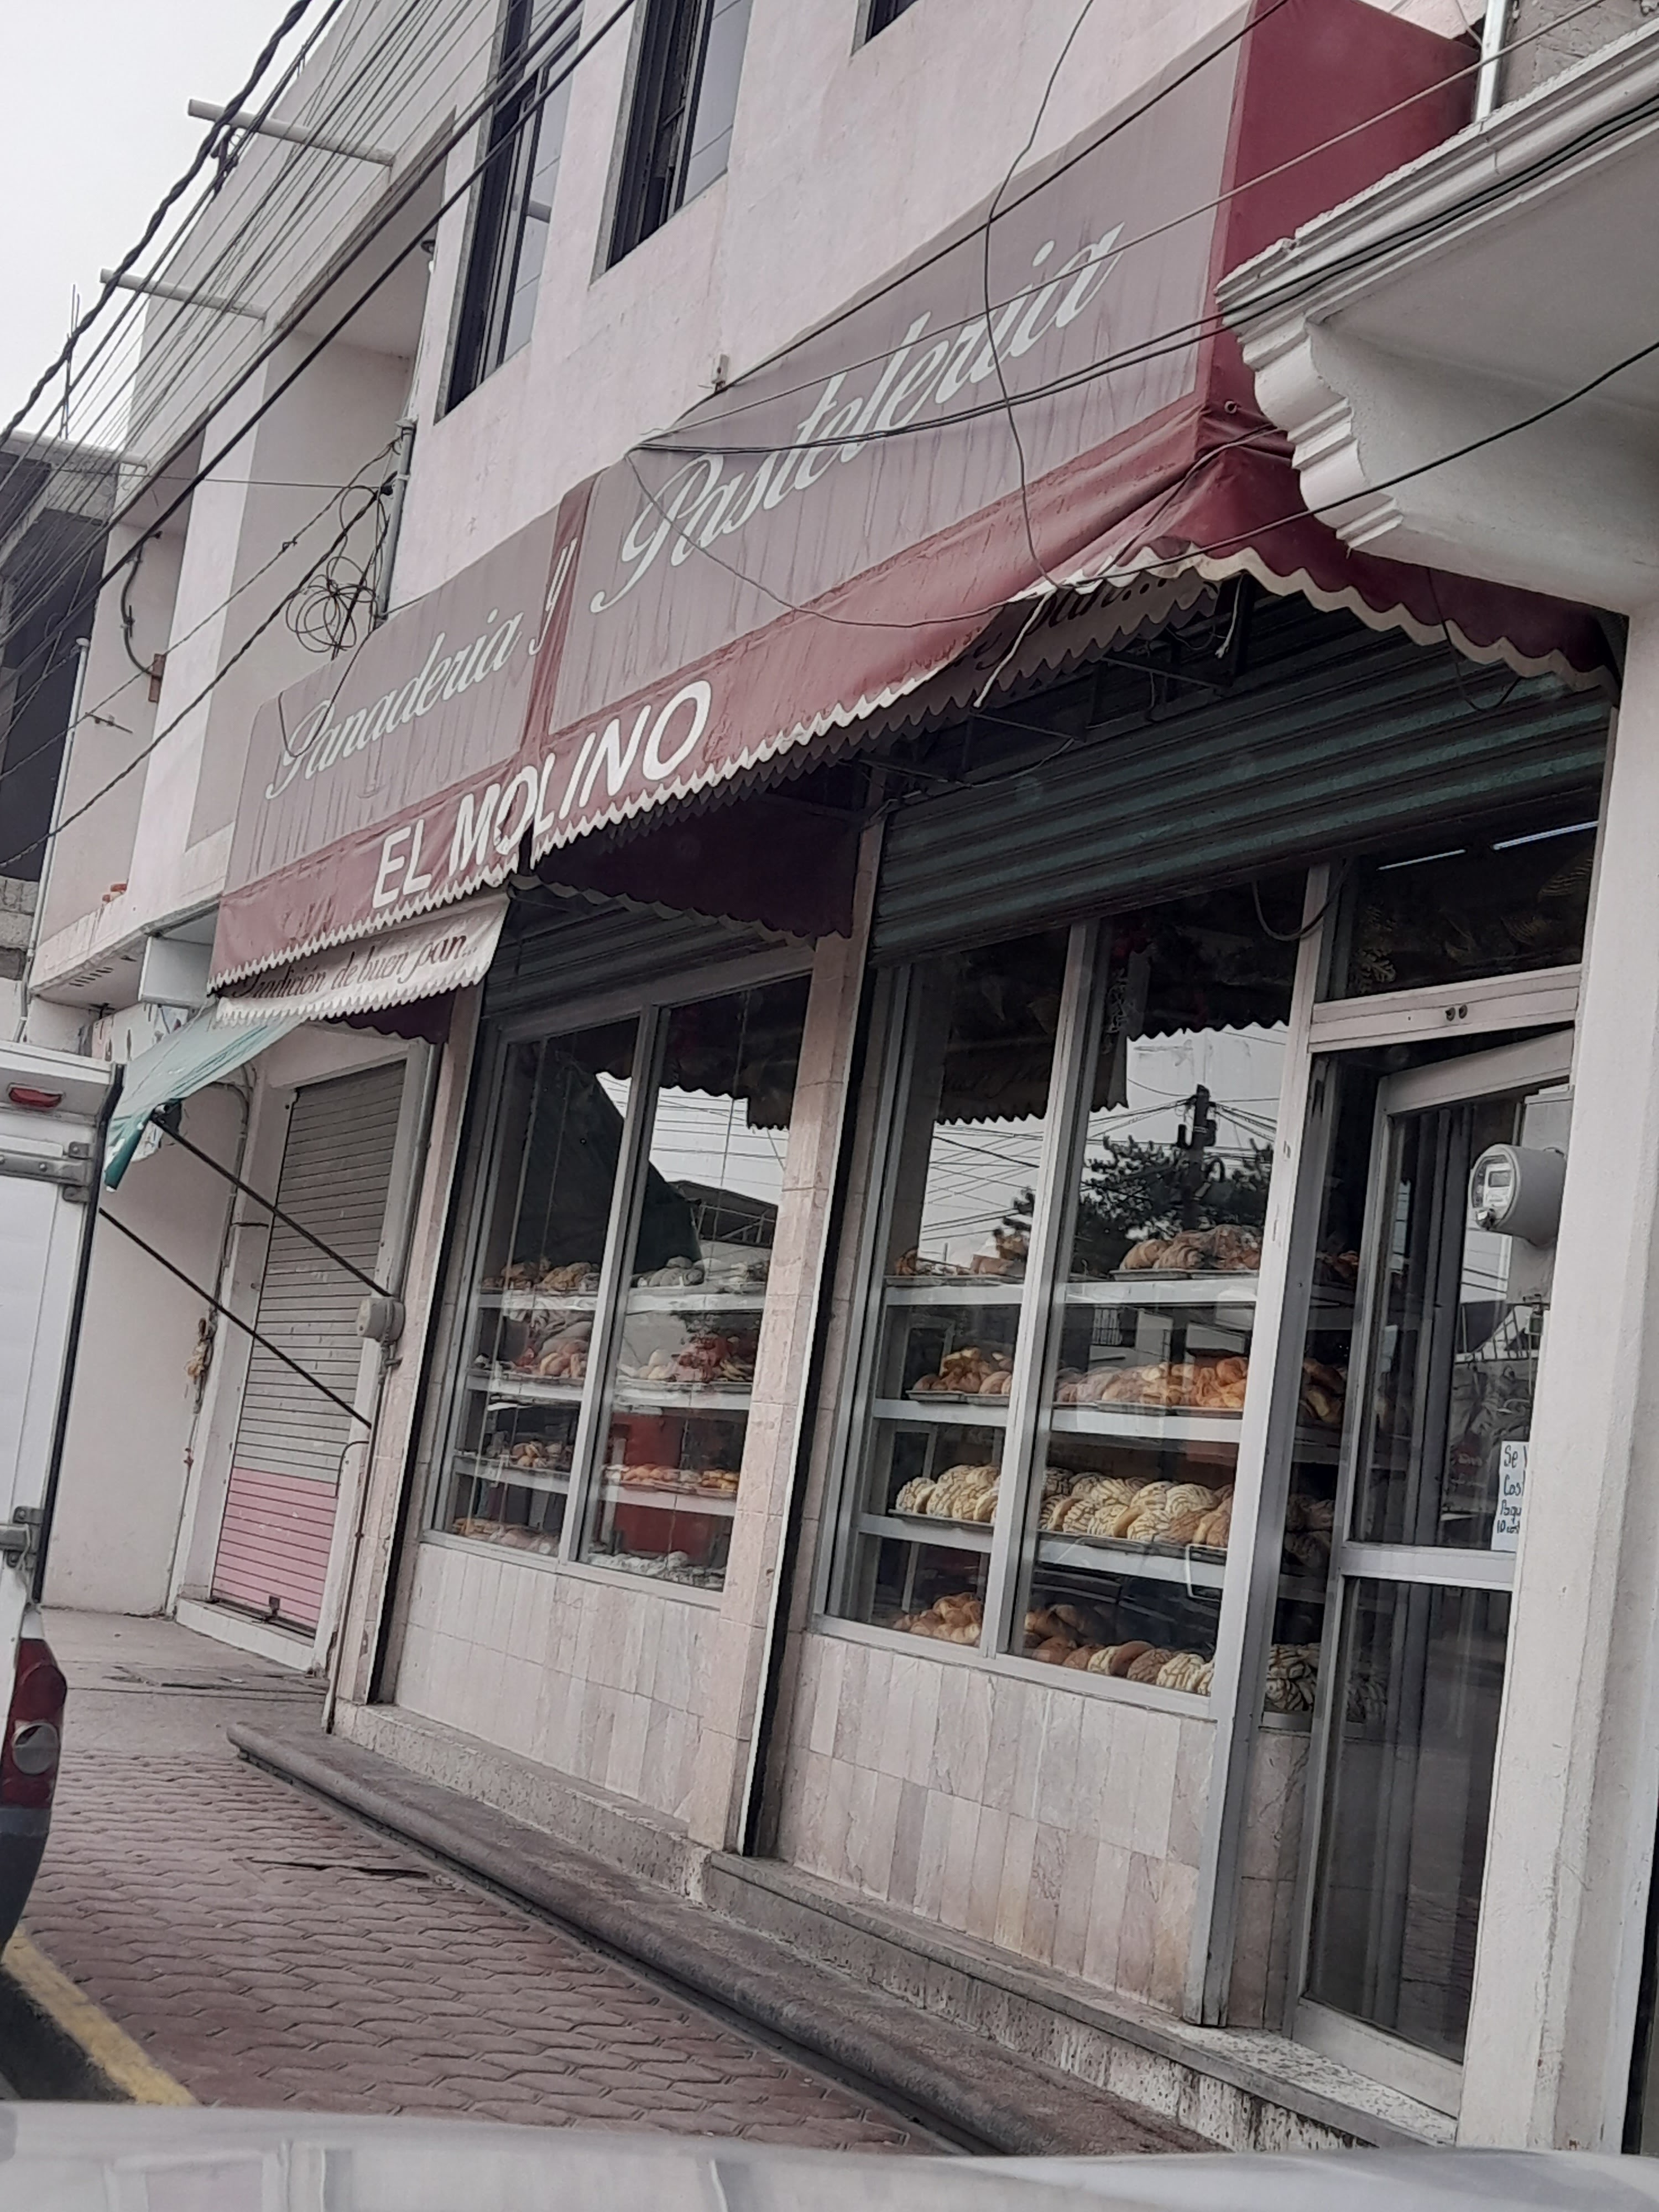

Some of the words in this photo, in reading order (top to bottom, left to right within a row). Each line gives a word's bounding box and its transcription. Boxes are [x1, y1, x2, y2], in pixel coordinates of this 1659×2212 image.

[529, 536, 578, 655] y
[372, 818, 432, 909] EL
[448, 680, 712, 877] MOLINO
[332, 951, 358, 990] de
[357, 946, 411, 984] buen
[1504, 1444, 1518, 1468] Se
